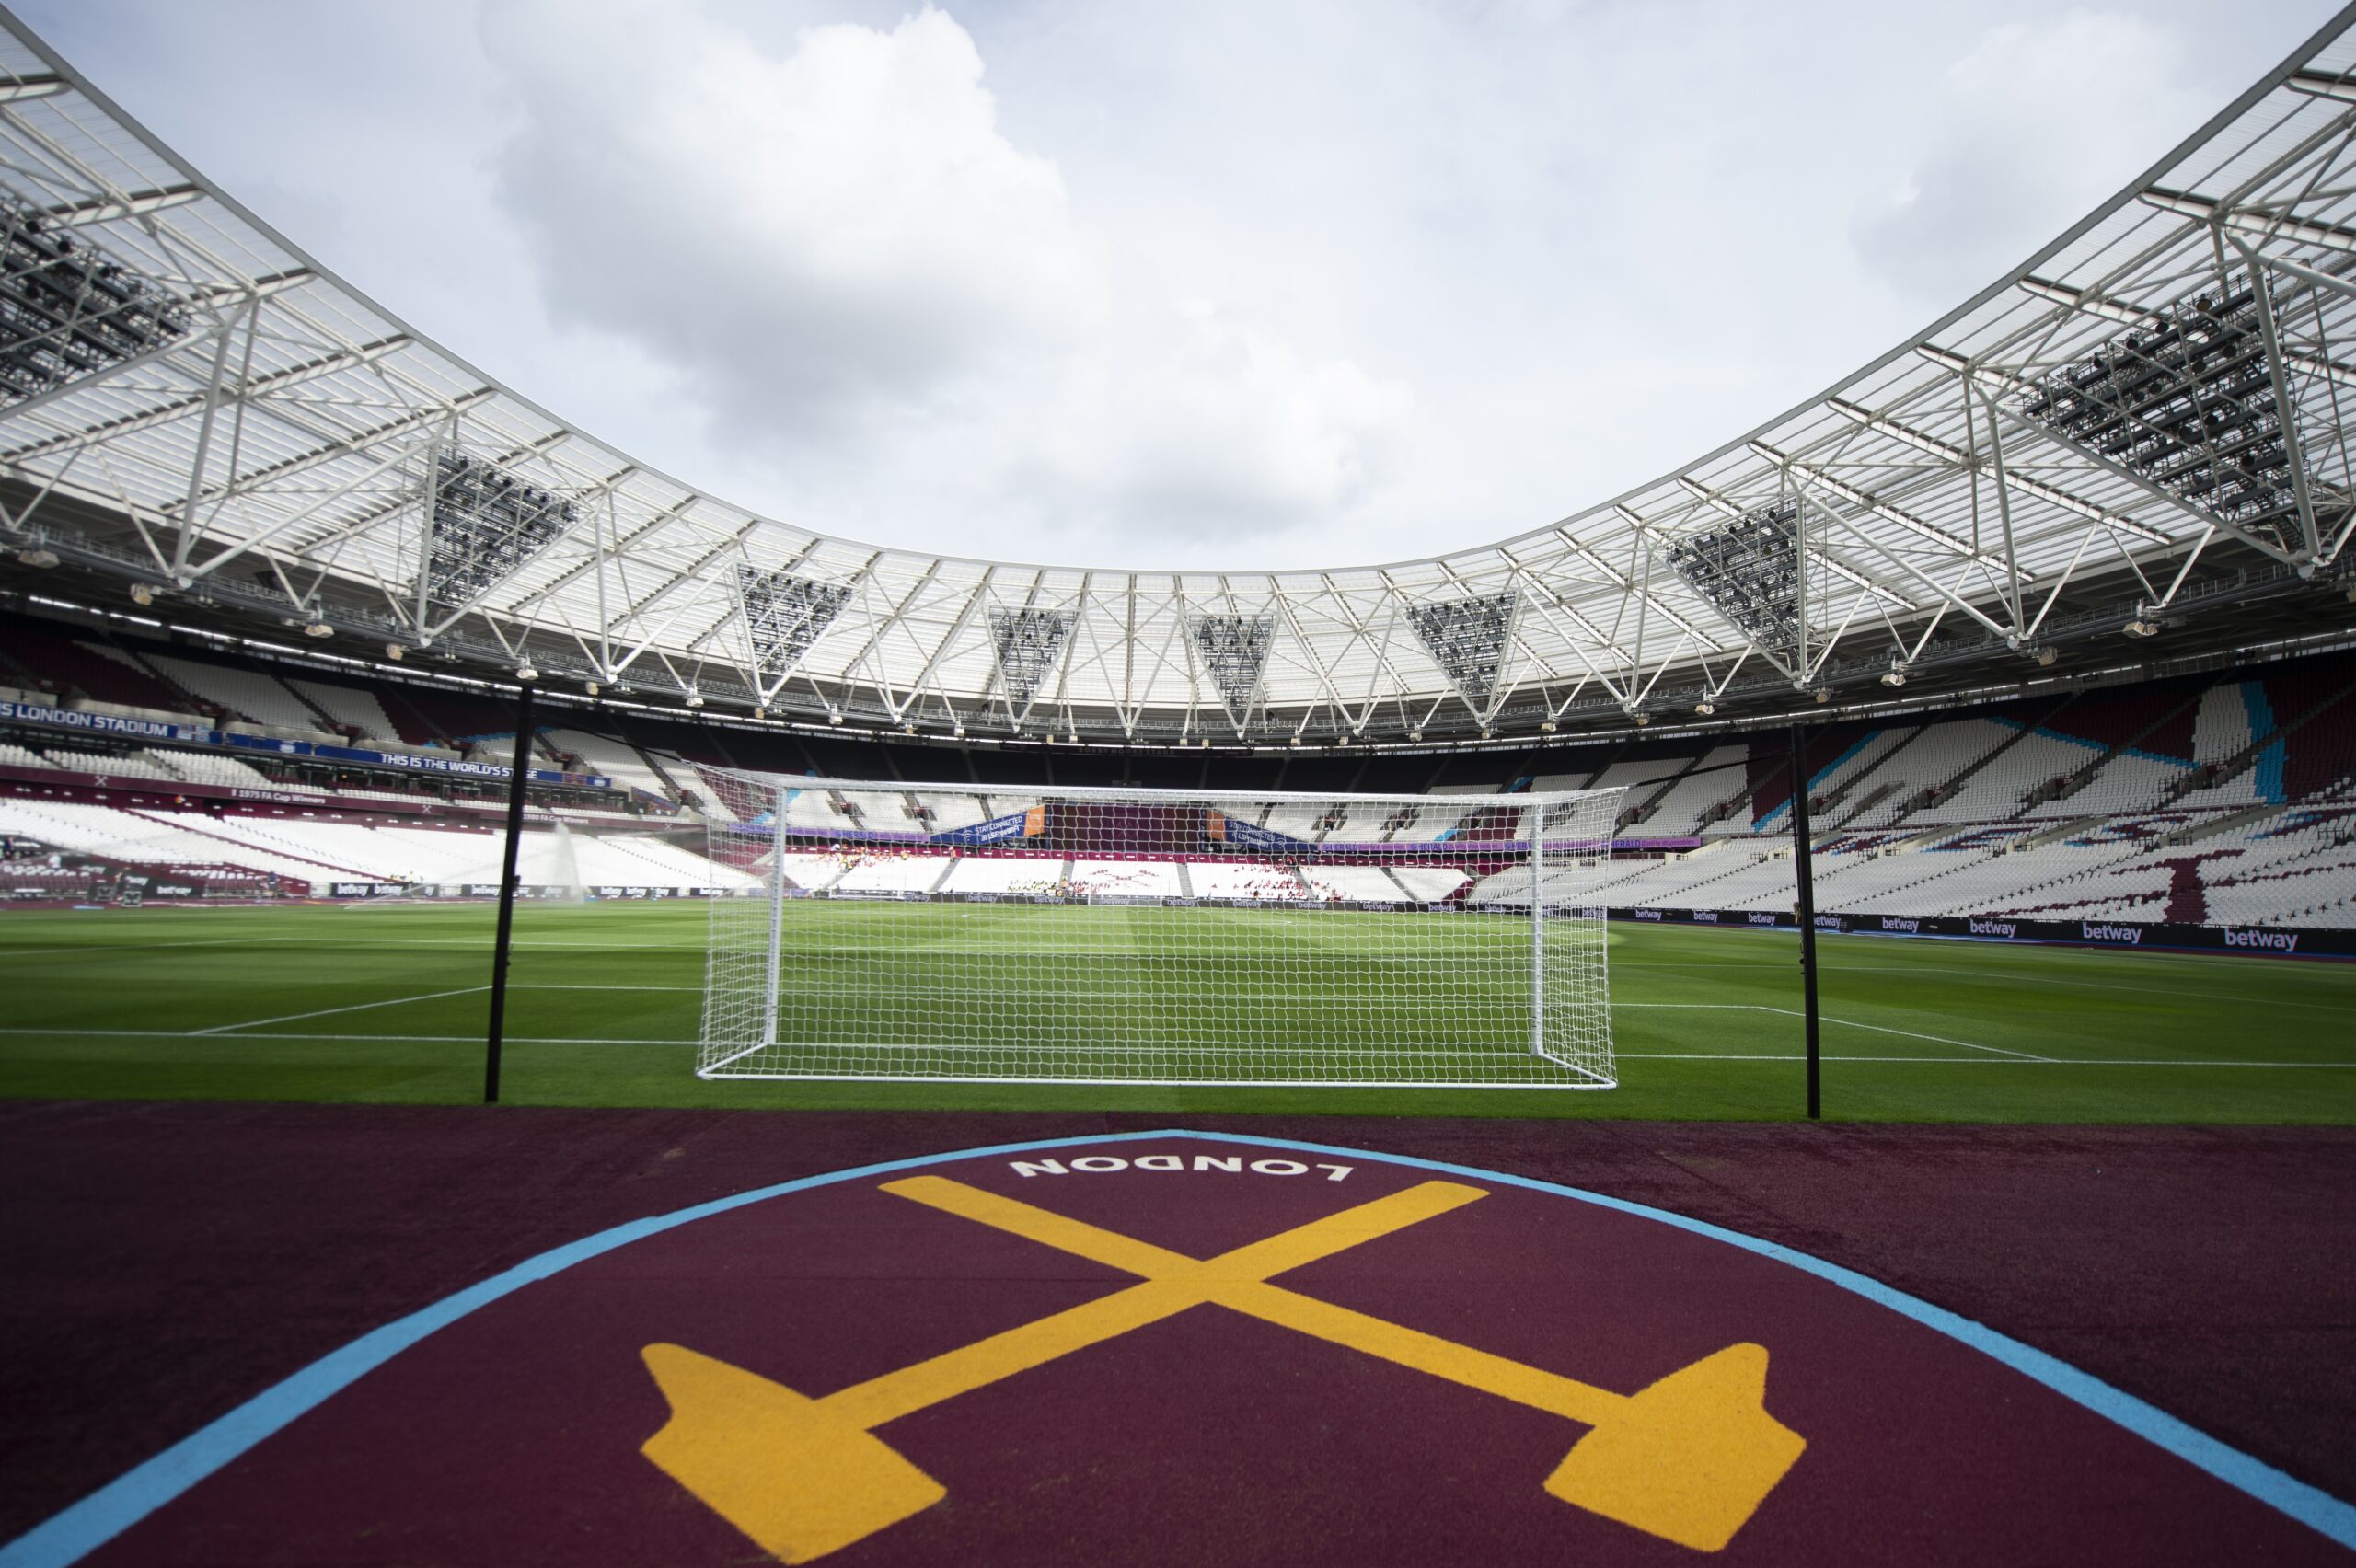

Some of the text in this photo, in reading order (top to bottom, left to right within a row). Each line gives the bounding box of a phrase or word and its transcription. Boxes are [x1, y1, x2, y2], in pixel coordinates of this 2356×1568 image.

[17, 705, 91, 726] LONDON
[94, 716, 168, 736] STADIUM
[380, 753, 408, 766] THIS
[410, 755, 421, 767] IS
[424, 758, 447, 770] THE
[449, 761, 501, 776] WORLD'S
[238, 790, 326, 804] 1975 FA Cup Winners
[1611, 839, 1640, 847] HERALD
[337, 883, 368, 896] betway
[904, 894, 930, 902] etway
[968, 894, 998, 903] betway
[1034, 895, 1065, 905] betway
[1232, 900, 1262, 908] betway
[1298, 901, 1327, 910] betway
[1362, 902, 1392, 911] betway
[1428, 903, 1457, 913] betway
[1635, 909, 1662, 920] betway
[1693, 911, 1718, 923] betway
[1749, 912, 1775, 926] betway
[1882, 917, 1919, 933] betway
[1969, 918, 2016, 938] betway
[2082, 922, 2142, 944] betway
[2224, 927, 2298, 952] betway
[1009, 1155, 1355, 1182] LONDON
